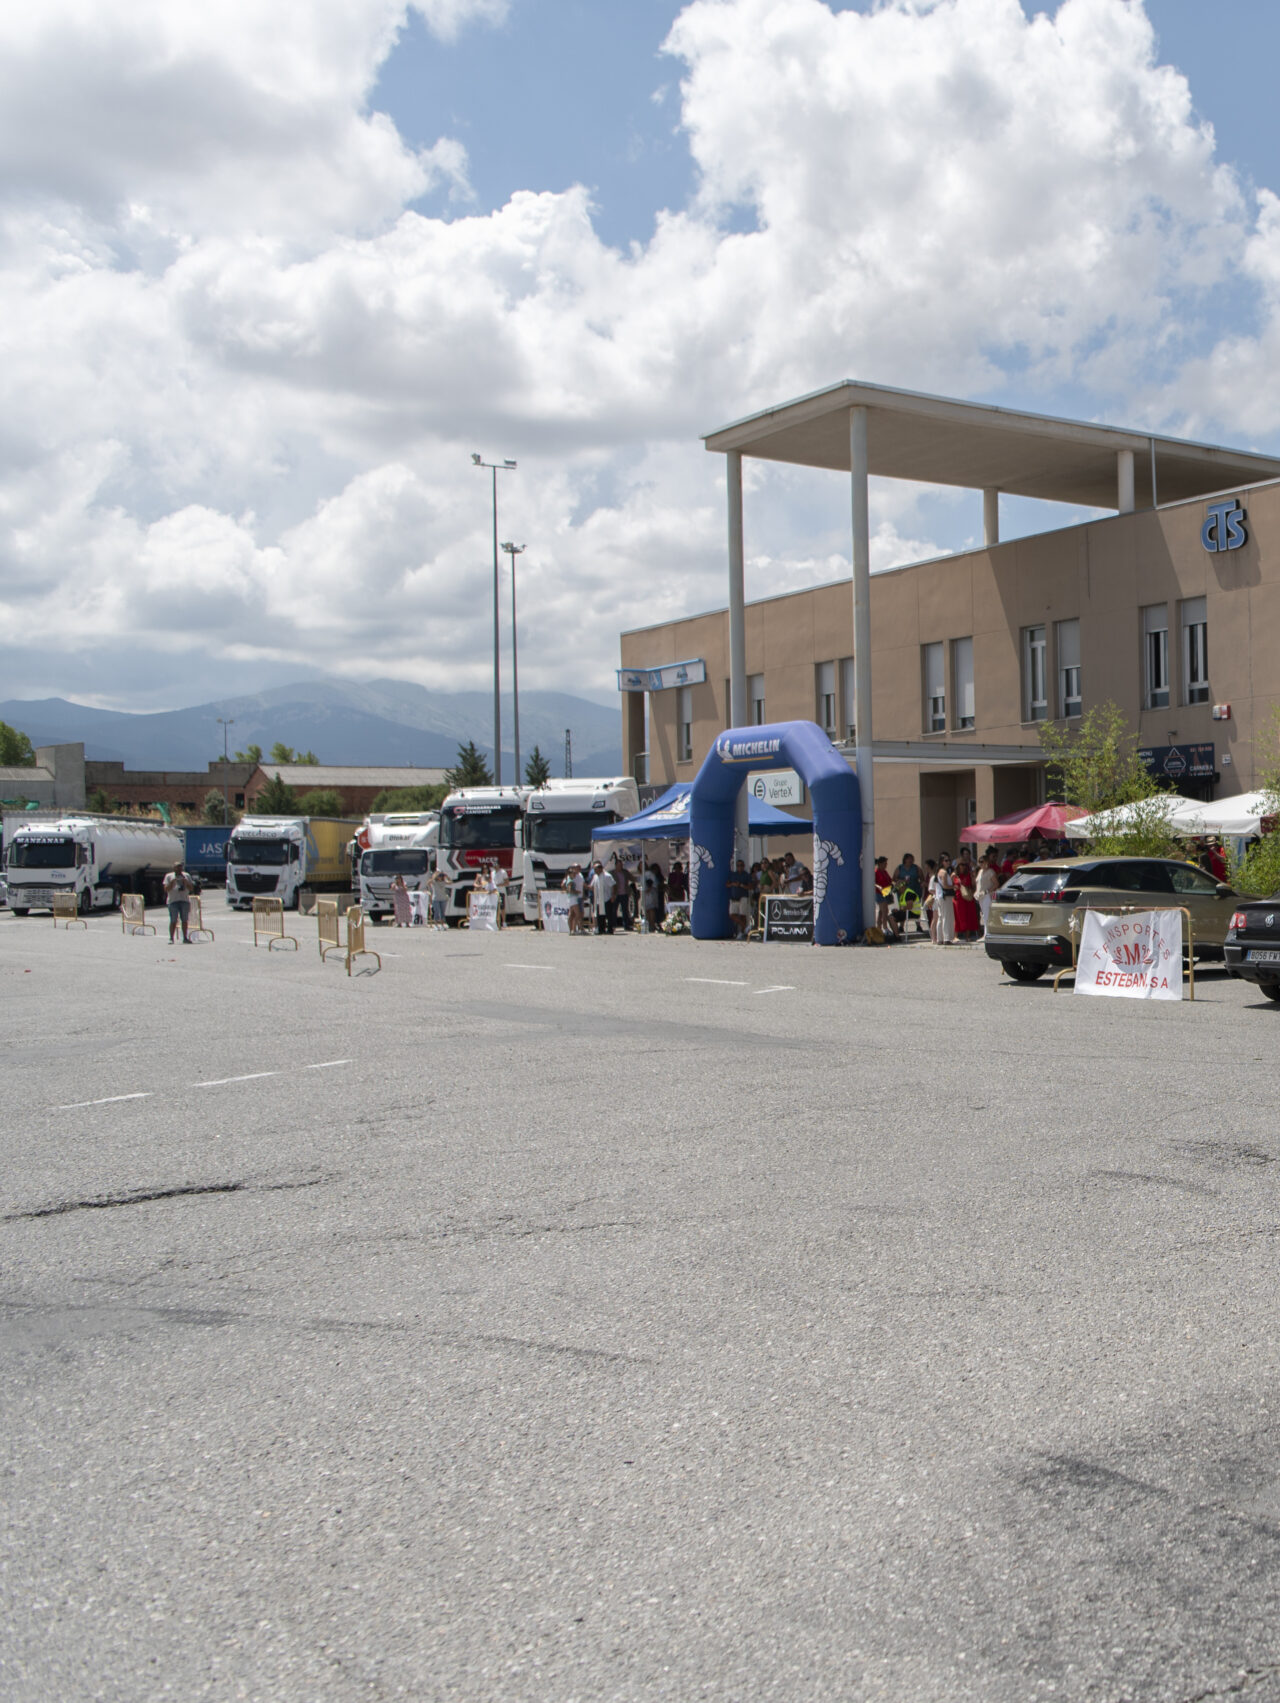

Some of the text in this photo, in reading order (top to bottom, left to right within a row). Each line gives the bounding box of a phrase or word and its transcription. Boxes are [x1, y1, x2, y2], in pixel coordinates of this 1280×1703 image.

[1201, 500, 1247, 552] CTS
[732, 739, 780, 756] MICHELIN
[1093, 923, 1170, 960] TRNSPORTES
